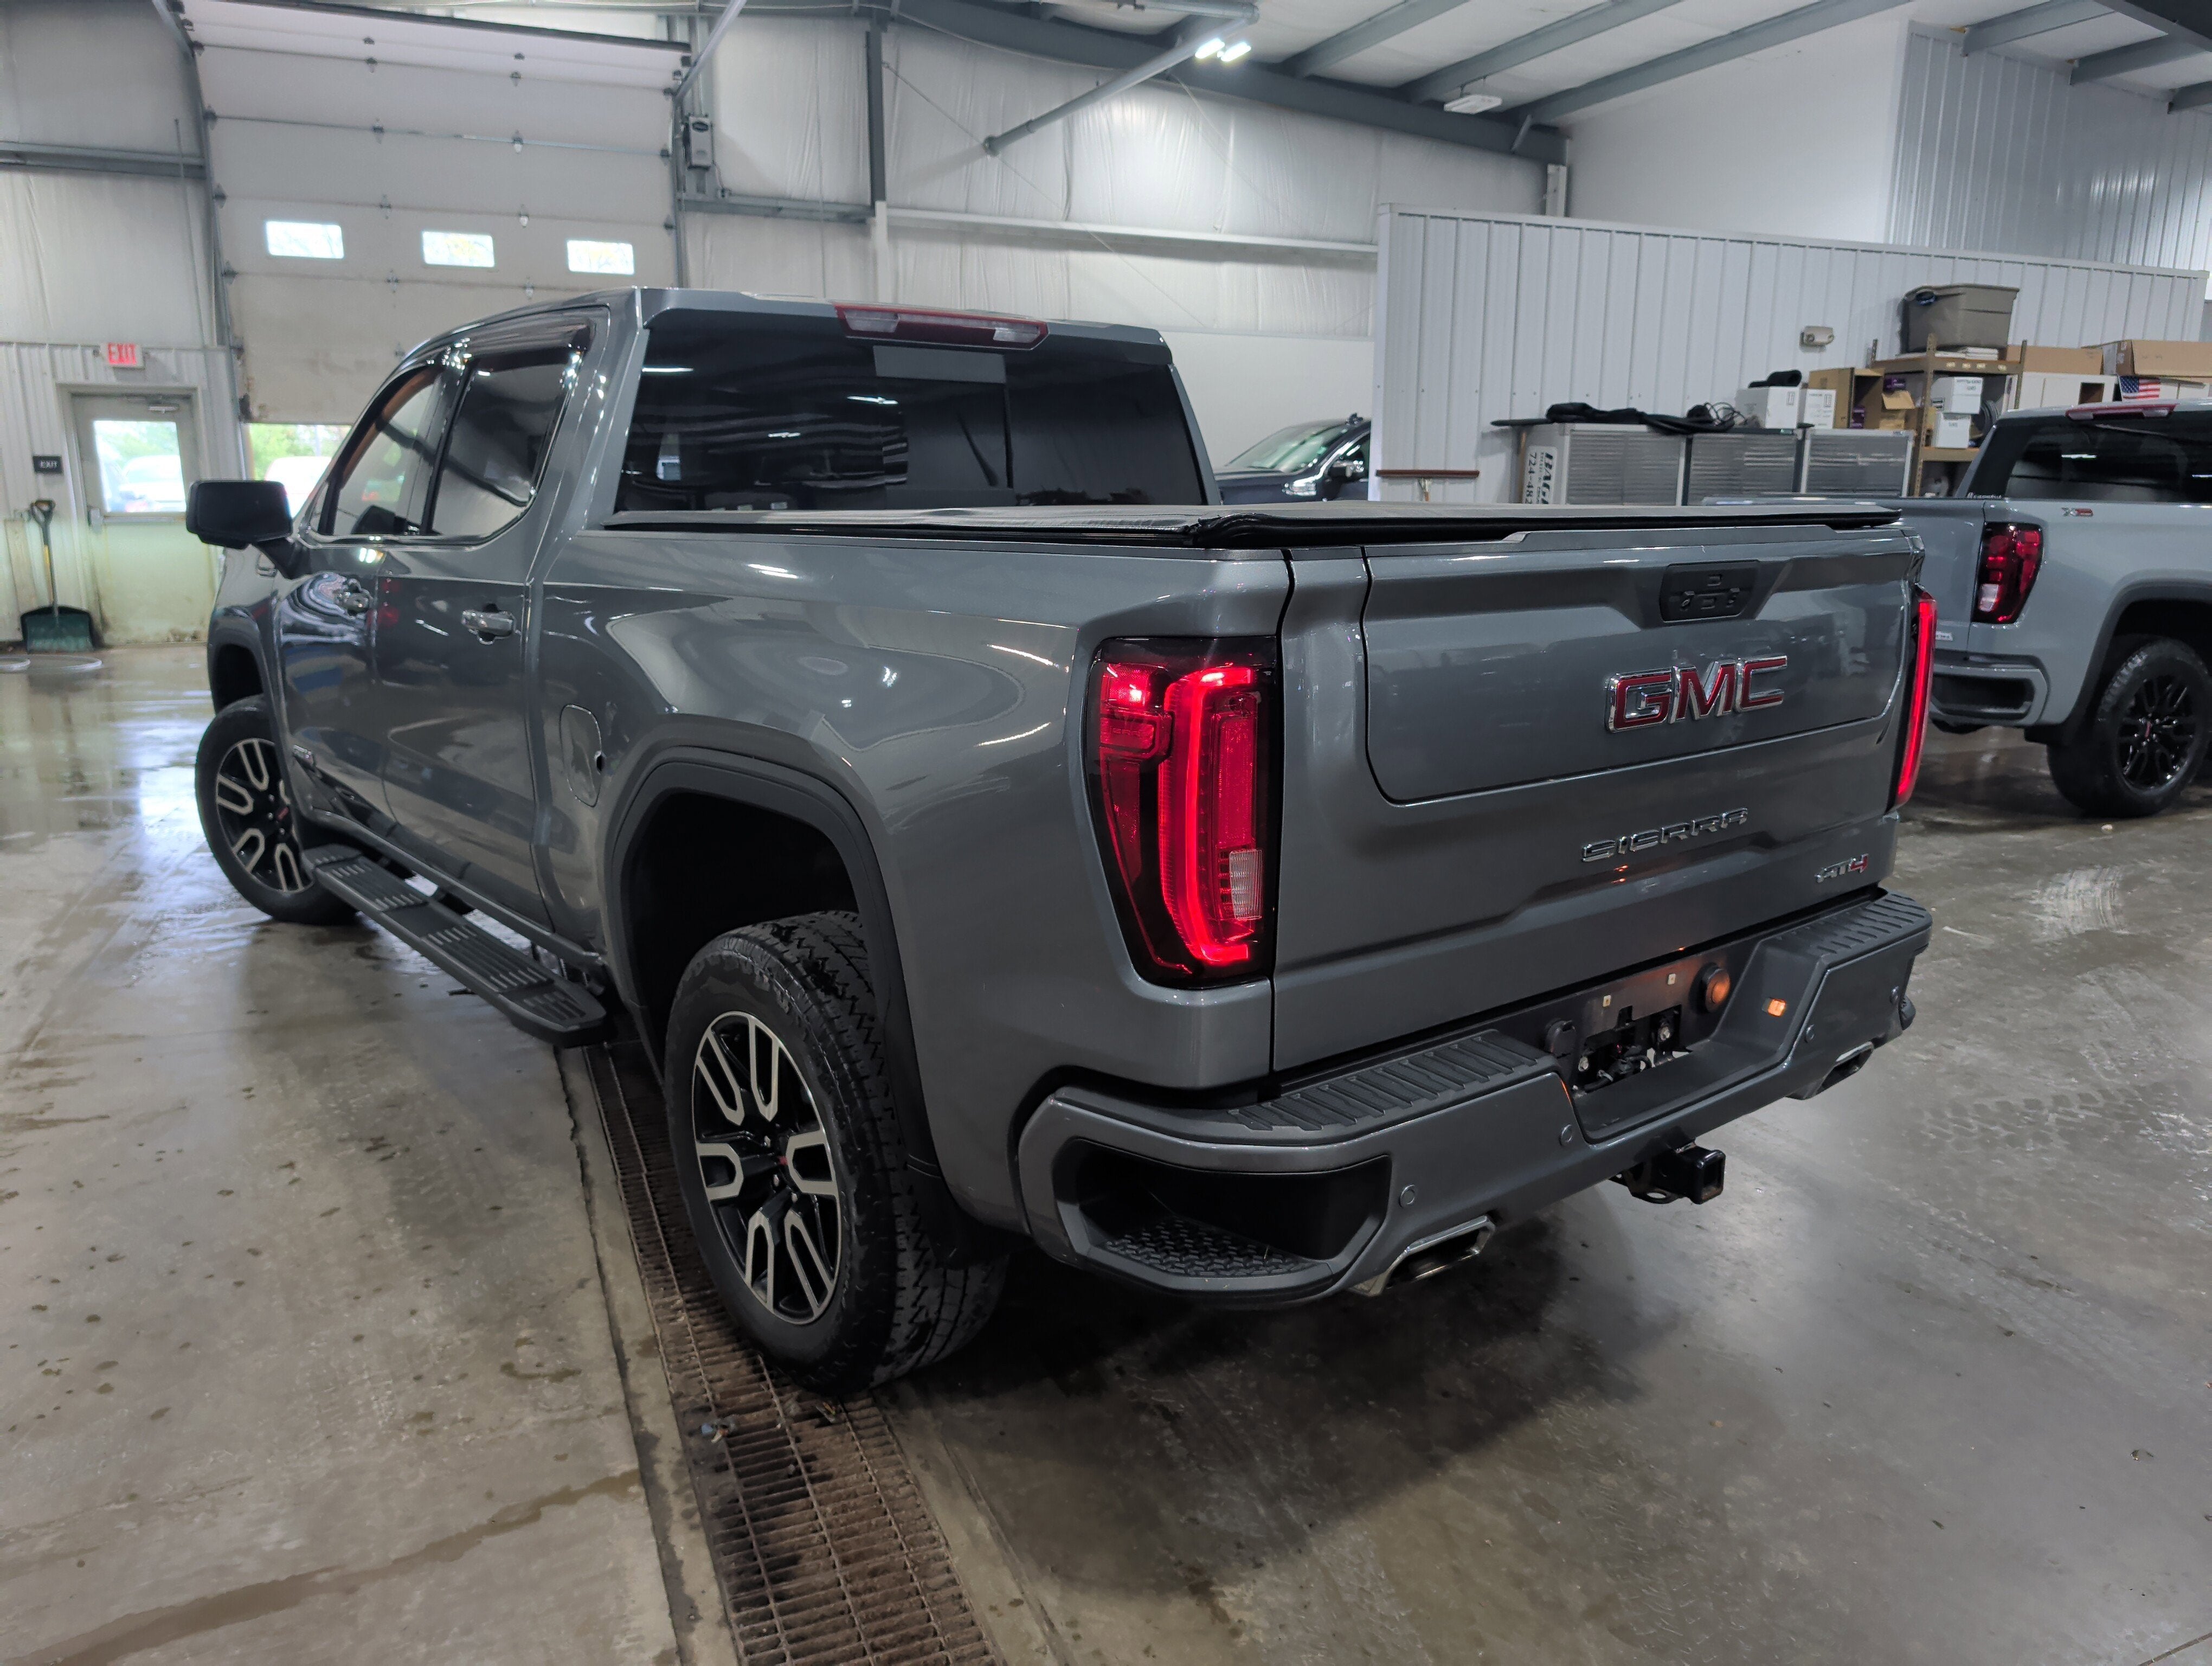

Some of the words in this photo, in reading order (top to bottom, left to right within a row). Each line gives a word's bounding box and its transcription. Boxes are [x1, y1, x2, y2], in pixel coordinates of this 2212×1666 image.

[108, 343, 136, 364] EXIT
[1603, 654, 1787, 734] GMC
[1580, 807, 1748, 863] SIERRA
[1815, 853, 1869, 883] AT4
